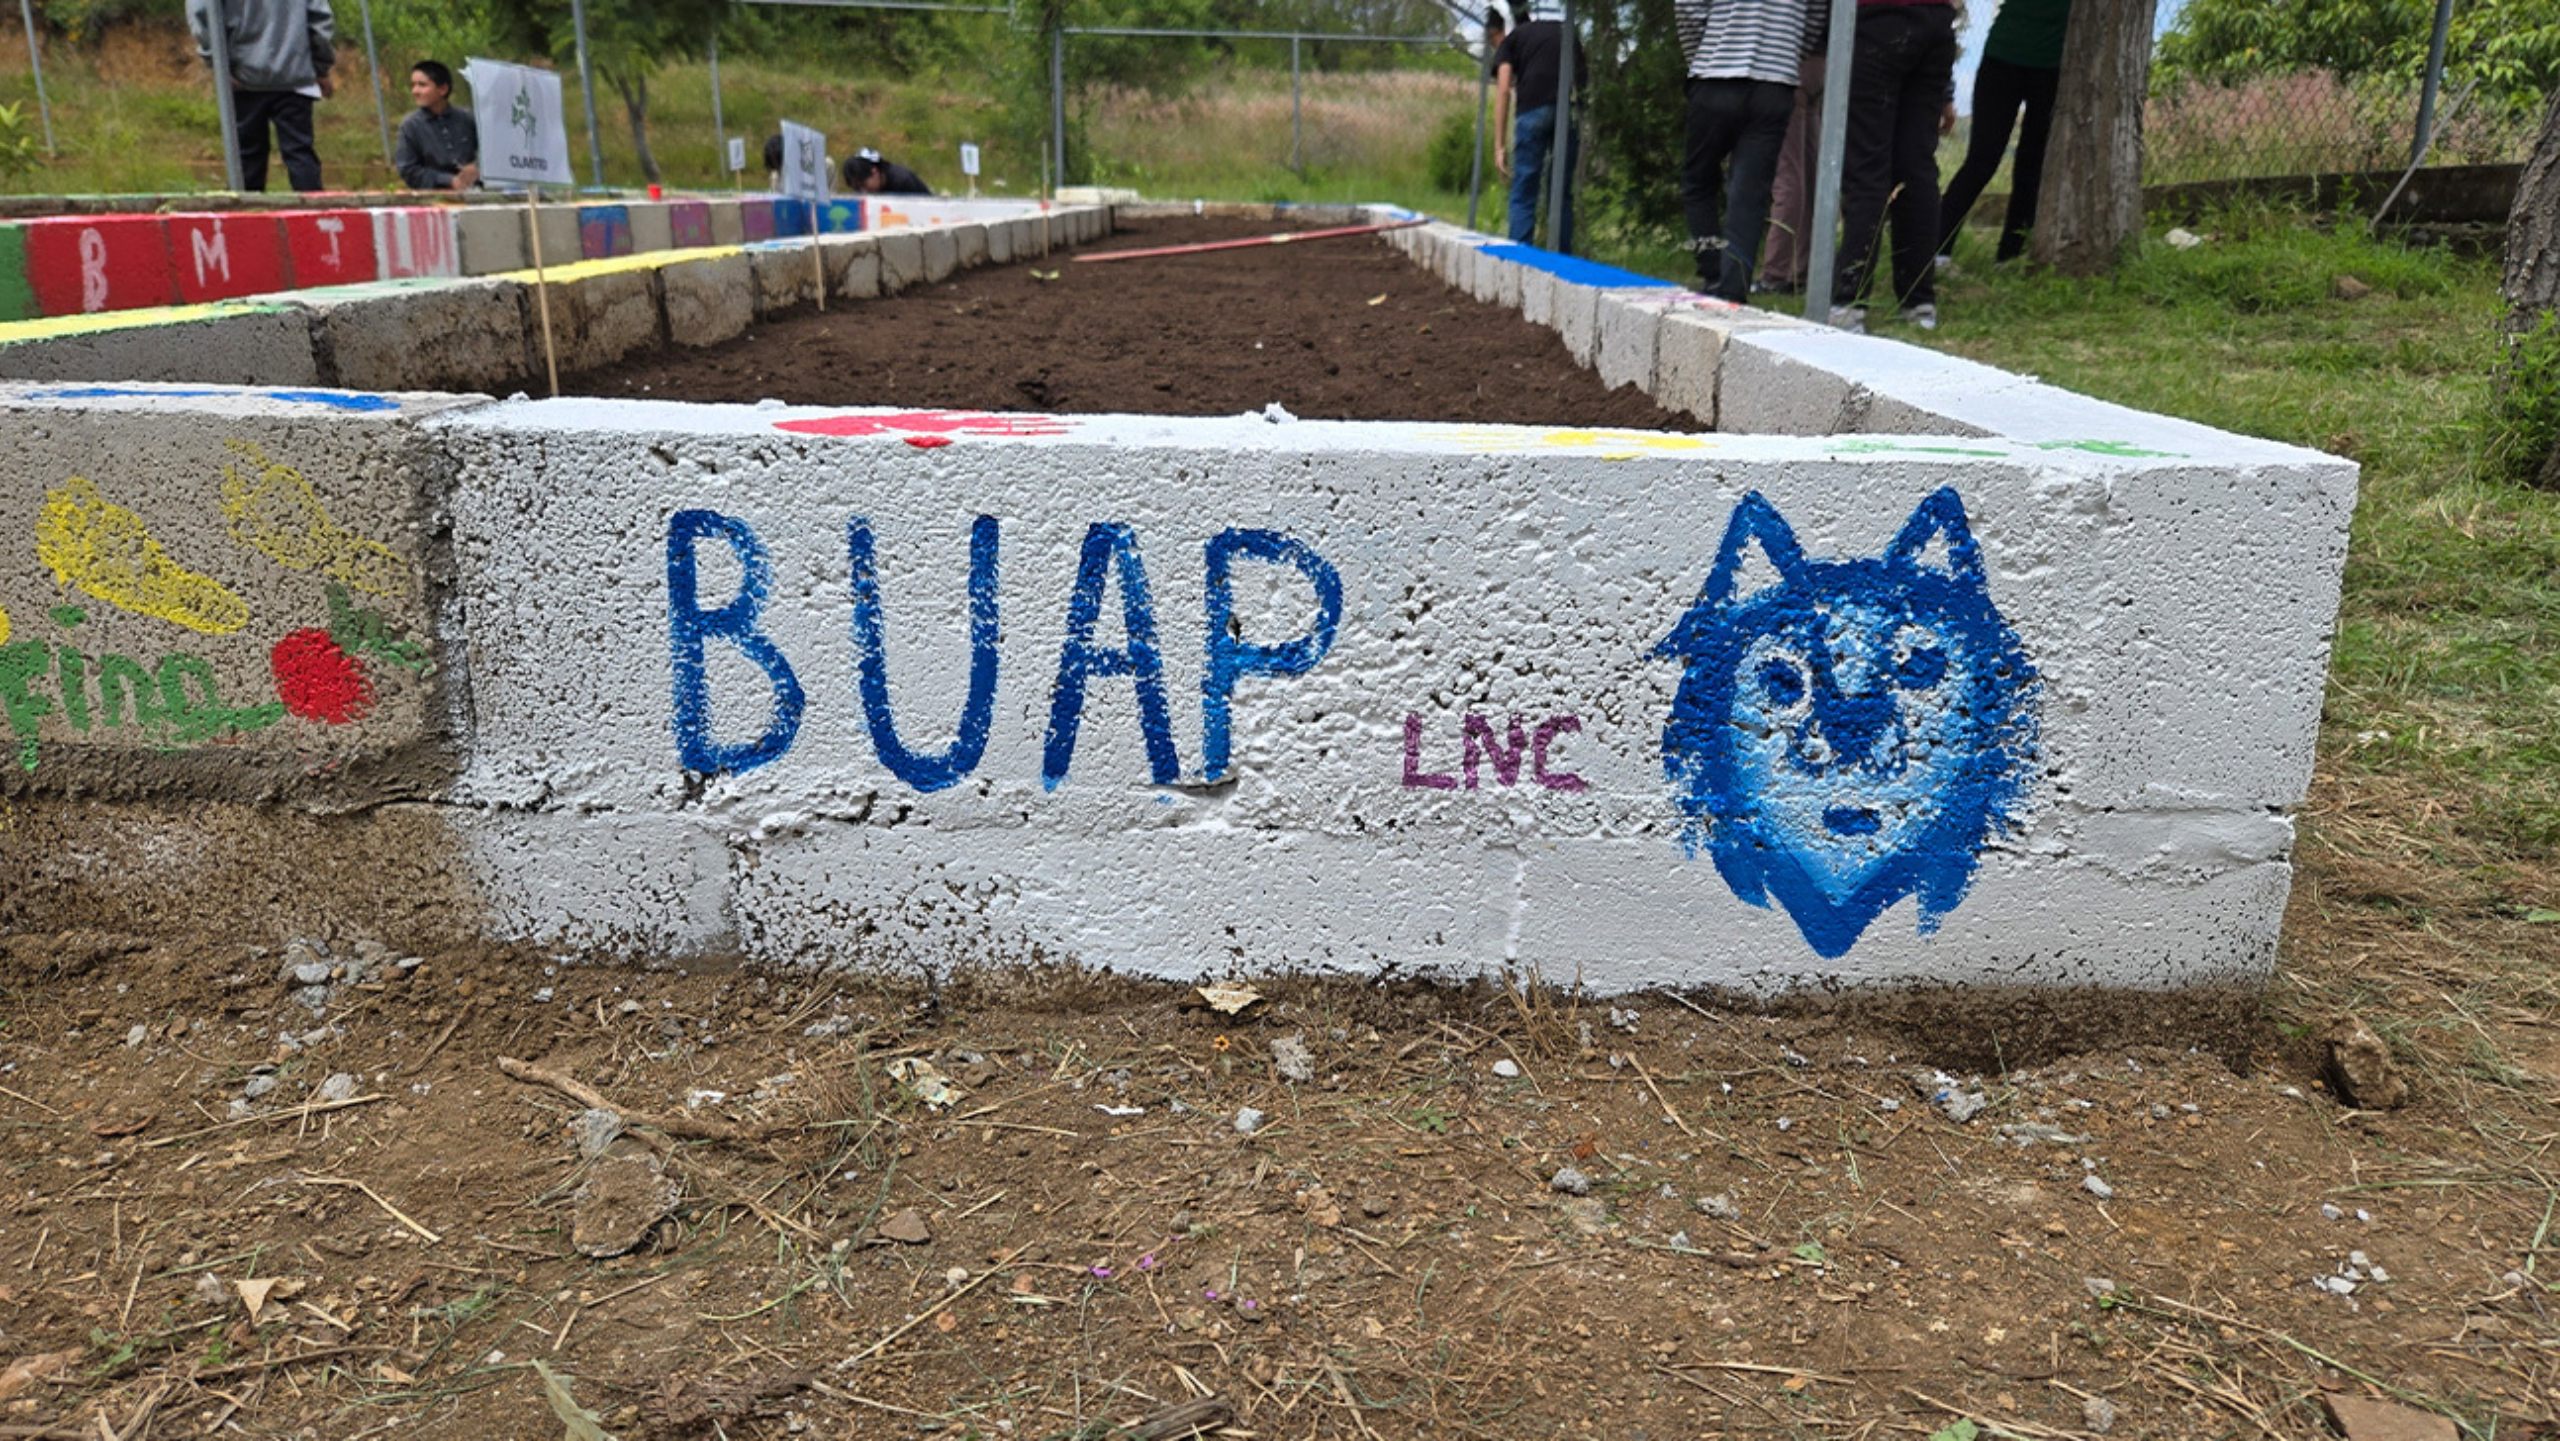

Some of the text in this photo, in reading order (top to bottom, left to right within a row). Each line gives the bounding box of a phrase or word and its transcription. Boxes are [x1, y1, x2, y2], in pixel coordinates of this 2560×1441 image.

[78, 227, 109, 313] B
[191, 217, 230, 287] M
[667, 508, 1344, 796] BUAP
[1402, 711, 1588, 793] LNC
